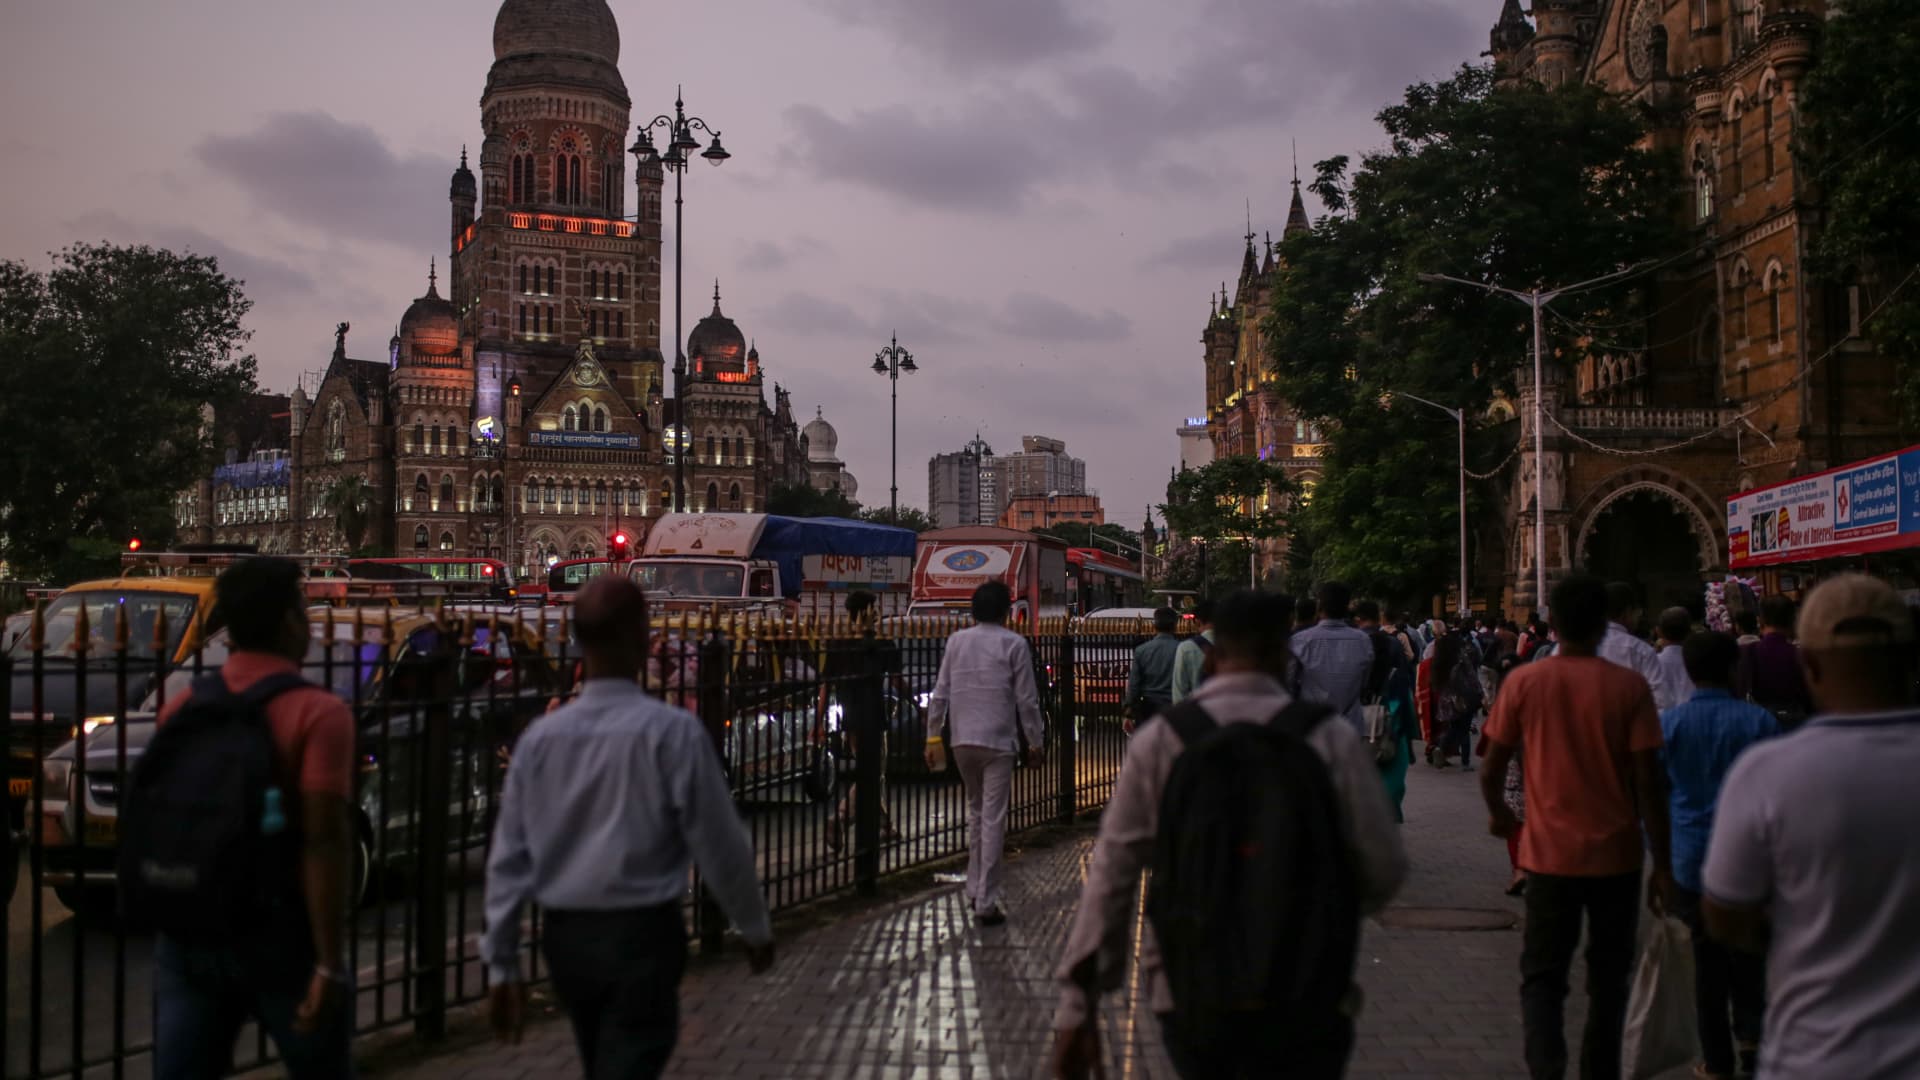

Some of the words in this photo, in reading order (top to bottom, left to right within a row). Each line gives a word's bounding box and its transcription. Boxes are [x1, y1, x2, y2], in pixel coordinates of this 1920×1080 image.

[1903, 471, 1917, 486] Your
[1797, 503, 1825, 521] Attractive
[1854, 508, 1868, 520] Central
[1868, 506, 1879, 517] Bank
[1879, 504, 1885, 516] of
[1885, 502, 1896, 513] India
[1790, 529, 1802, 546] Rate
[1803, 528, 1809, 543] of
[1811, 525, 1834, 544] Interest
